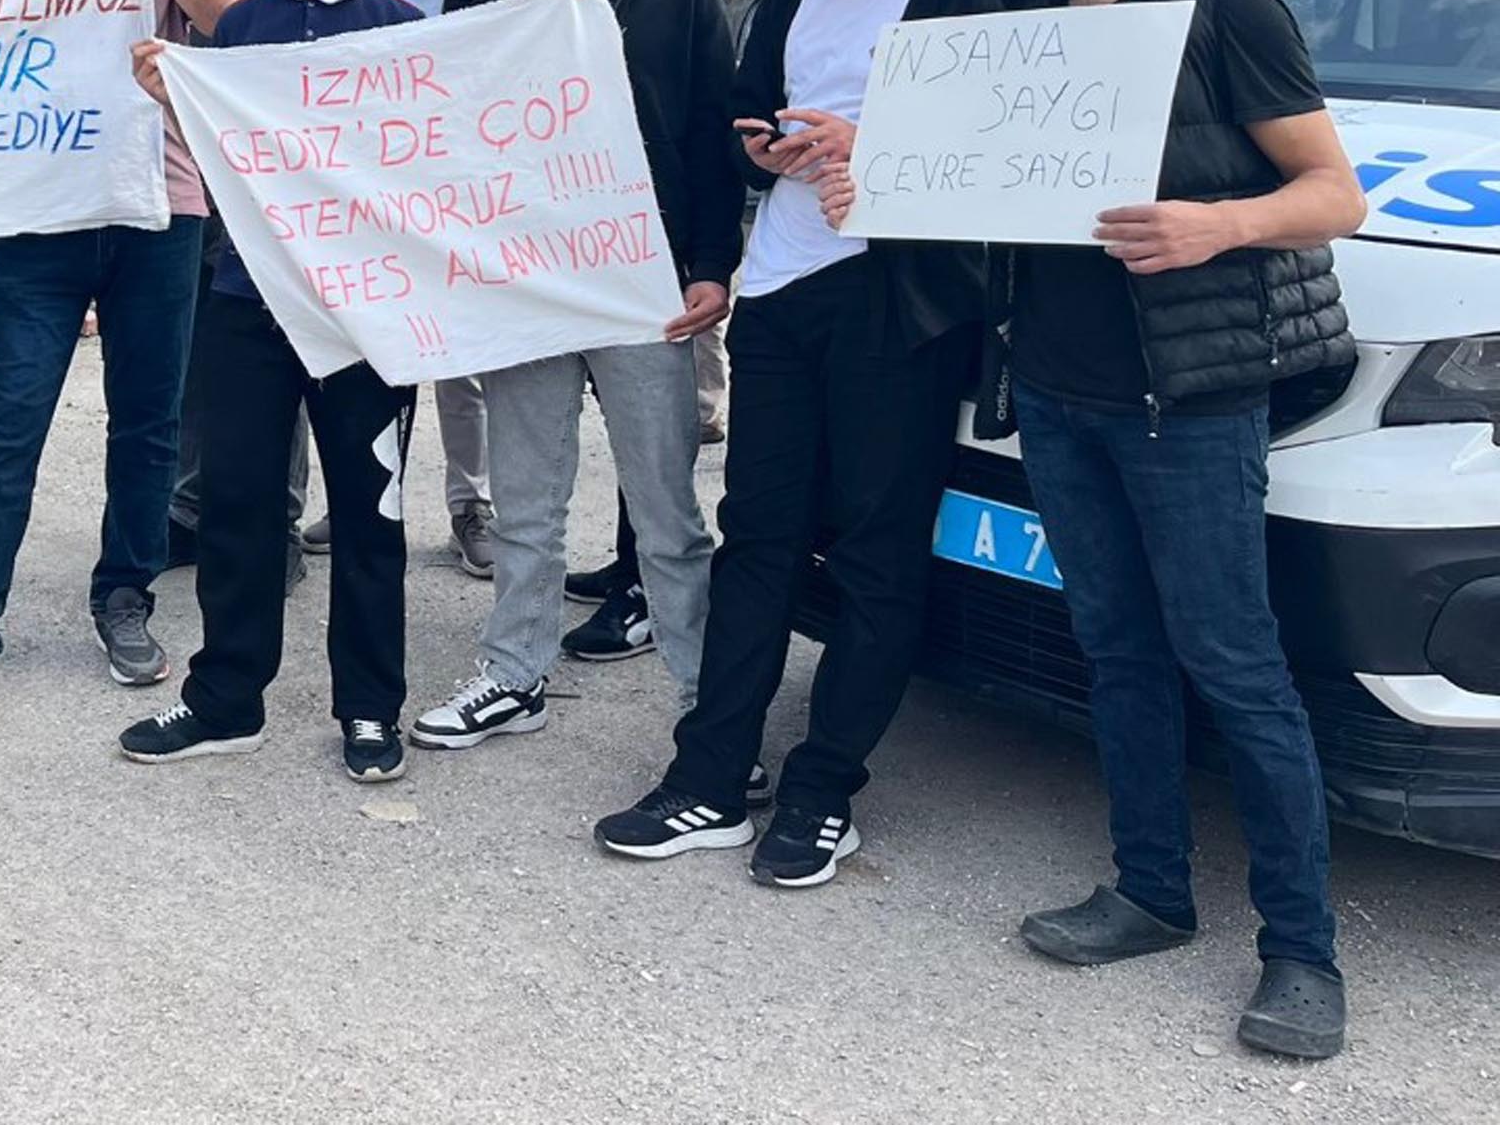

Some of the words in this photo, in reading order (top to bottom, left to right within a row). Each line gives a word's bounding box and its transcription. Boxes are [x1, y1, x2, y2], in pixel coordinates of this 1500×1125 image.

[301, 53, 451, 109] İZMİR
[882, 22, 1067, 87] İNSANA
[478, 77, 591, 154] ÇÖP
[977, 79, 1121, 133] SAYGI
[264, 172, 526, 241] STEMİYORUZ
[864, 151, 985, 209] ÇEVRE
[974, 509, 996, 562] A
